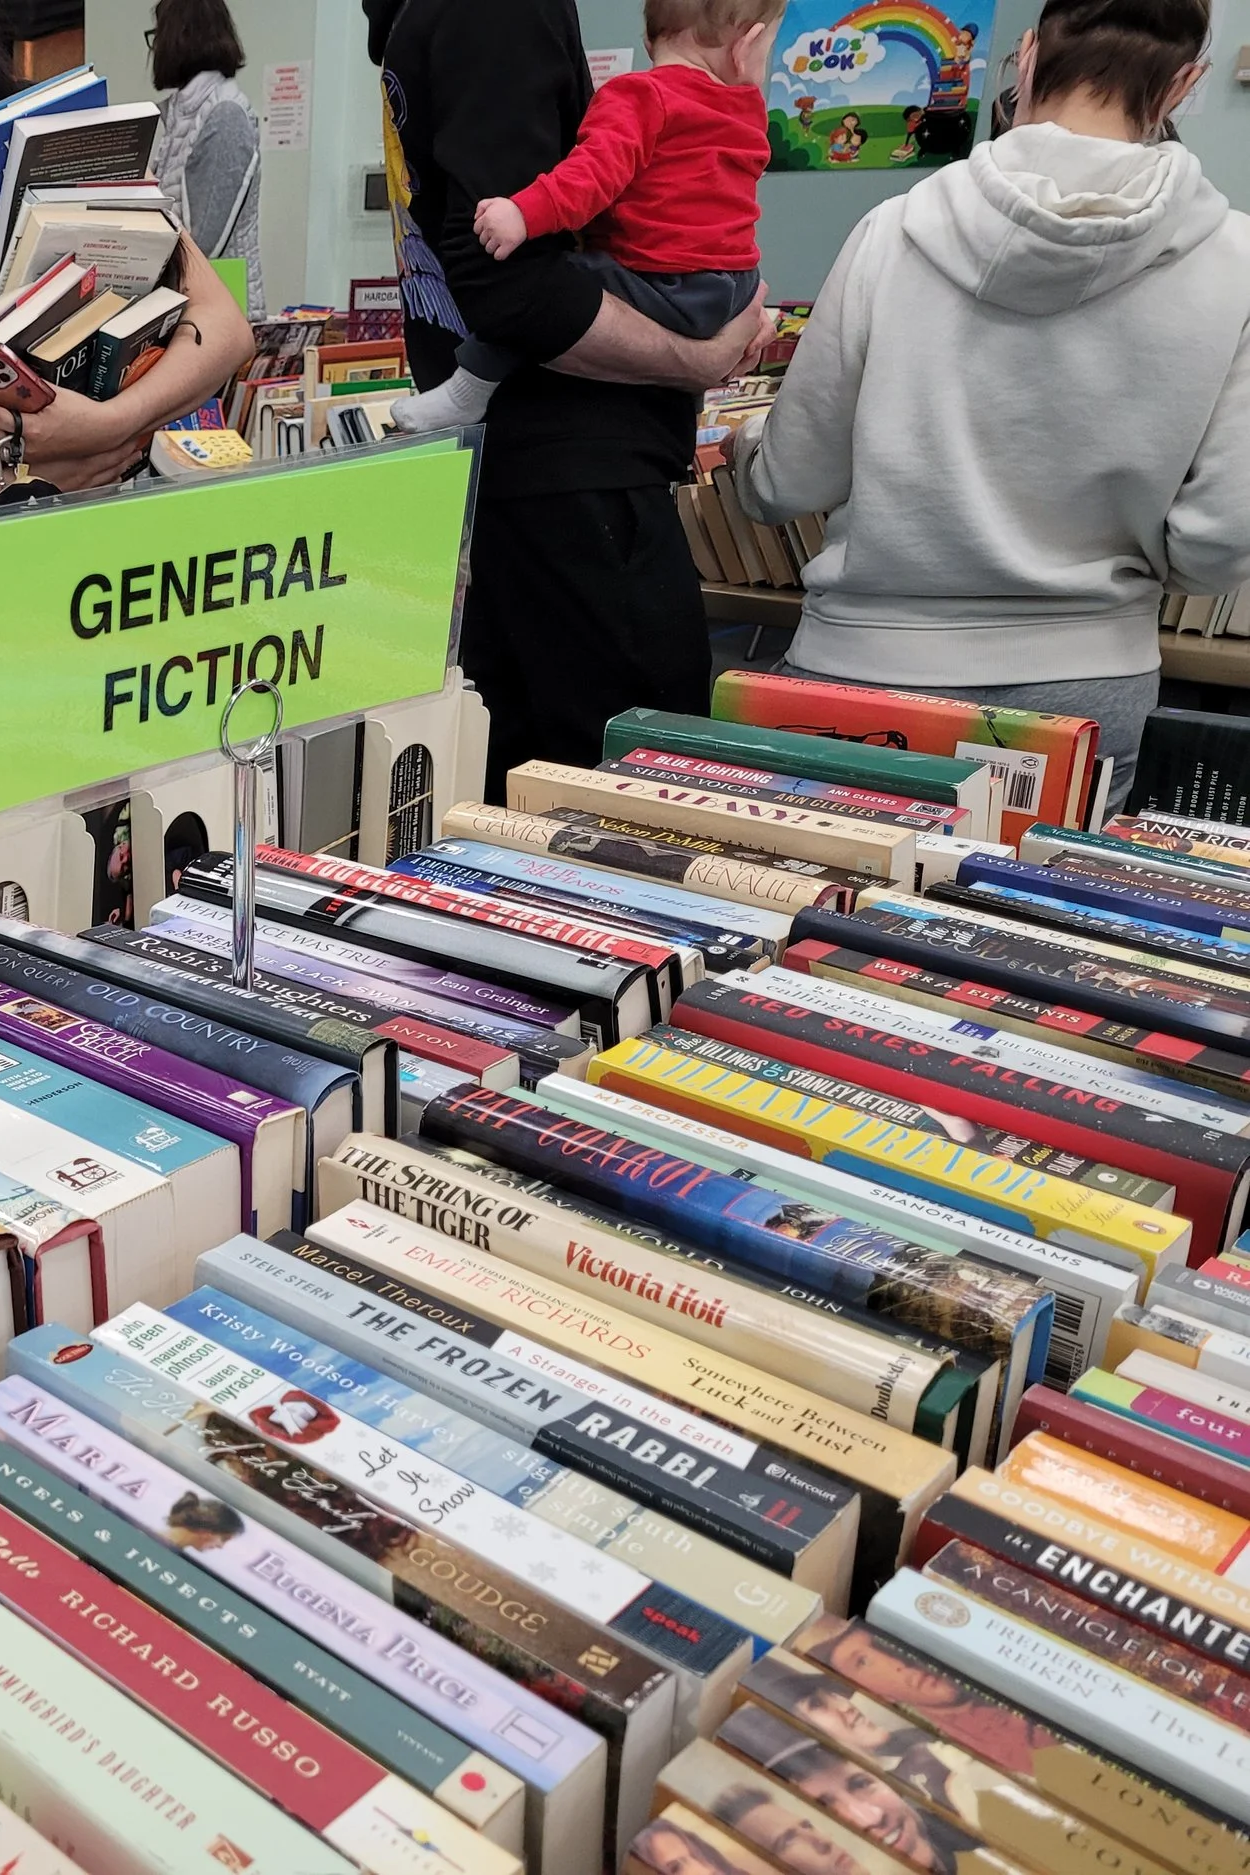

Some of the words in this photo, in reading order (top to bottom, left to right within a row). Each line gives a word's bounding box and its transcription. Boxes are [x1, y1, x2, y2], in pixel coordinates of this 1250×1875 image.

[793, 53, 868, 73] BOOKS
[56, 346, 87, 387] JOE
[70, 531, 348, 640] GENERAL
[102, 624, 324, 732] FICTION
[887, 690, 947, 706] James
[950, 699, 1029, 718] McBride
[630, 764, 697, 789] SILENT
[697, 776, 761, 796] VOICES
[653, 754, 695, 772] BLUE
[695, 760, 774, 785] LIGHTNING
[1196, 762, 1204, 779] 2017
[1173, 786, 1184, 814] FINALIST
[472, 816, 552, 846] GAMES
[595, 815, 654, 843] Nelson
[654, 828, 727, 857] DeMille
[1132, 820, 1199, 840] ANNE
[688, 860, 808, 905] RENAULT
[975, 854, 1030, 874] every
[1035, 869, 1081, 884] now
[1084, 881, 1129, 894] and
[1133, 891, 1184, 907] then
[1101, 873, 1154, 890] Chatwin
[85, 982, 141, 1008] OLD
[144, 1002, 271, 1056] COUNTRY
[474, 979, 551, 1018] Grainger
[872, 961, 935, 988] WATER
[966, 988, 1082, 1024] ELEPHANTS
[385, 1023, 459, 1052] ANTON
[738, 993, 812, 1020] RED
[823, 1019, 933, 1057] SKIES
[948, 1055, 1123, 1116] FALLING
[26, 1080, 84, 1107] HENDERSON
[695, 1037, 769, 1074] KILLINGS
[777, 1068, 860, 1110] STANLEY
[848, 1086, 922, 1125] KETCHEL
[629, 1103, 750, 1152] PROFESSOR
[992, 1134, 1030, 1162] JAMES
[535, 1117, 711, 1200] CONROY
[840, 1114, 1053, 1202] TREVOR
[1044, 1152, 1087, 1177] BLAKE
[390, 1159, 495, 1220] SPRING
[405, 1192, 493, 1252] TIGER
[868, 1188, 968, 1229] SHANORA
[976, 1225, 1084, 1269] WILLIAMS
[291, 1243, 377, 1288] Marcel
[377, 1281, 476, 1335] Theroux
[402, 1245, 491, 1293] EMILIE
[497, 1282, 655, 1361] RICHARDS
[562, 1239, 662, 1304] Victoria
[658, 1280, 731, 1329] Holt
[777, 1283, 844, 1315] JOHN
[148, 1333, 200, 1367] maureen
[164, 1342, 220, 1381] johnson
[195, 1301, 264, 1344] Kristy
[268, 1336, 369, 1398] Woodson
[374, 1392, 462, 1446] Harvey
[209, 1366, 266, 1406] myracle
[345, 1301, 419, 1343] THE
[415, 1336, 564, 1414] FROZEN
[575, 1411, 720, 1491] RABBI
[527, 1352, 608, 1398] Stranger
[612, 1388, 634, 1408] in
[678, 1421, 735, 1457] Earth
[681, 1356, 796, 1412] Somewhere
[688, 1375, 748, 1412] Luck
[791, 1417, 856, 1457] Trust
[1175, 1408, 1242, 1439] four
[8, 1396, 152, 1500] MARIA
[416, 1481, 477, 1526] Snow
[123, 1546, 259, 1639] INSECTS
[406, 1547, 551, 1635] GOUDGE
[988, 1573, 1142, 1655] CANTICLE
[250, 1550, 381, 1645] EUGENIA
[381, 1632, 482, 1710] PRICE
[641, 1604, 702, 1644] speak
[59, 1588, 203, 1692] RICHARD
[205, 1691, 324, 1779] RUSSO
[984, 1616, 1135, 1700] FREDERICK
[993, 1644, 1097, 1701] REIKEN
[96, 1750, 199, 1833] DAUGHTER
